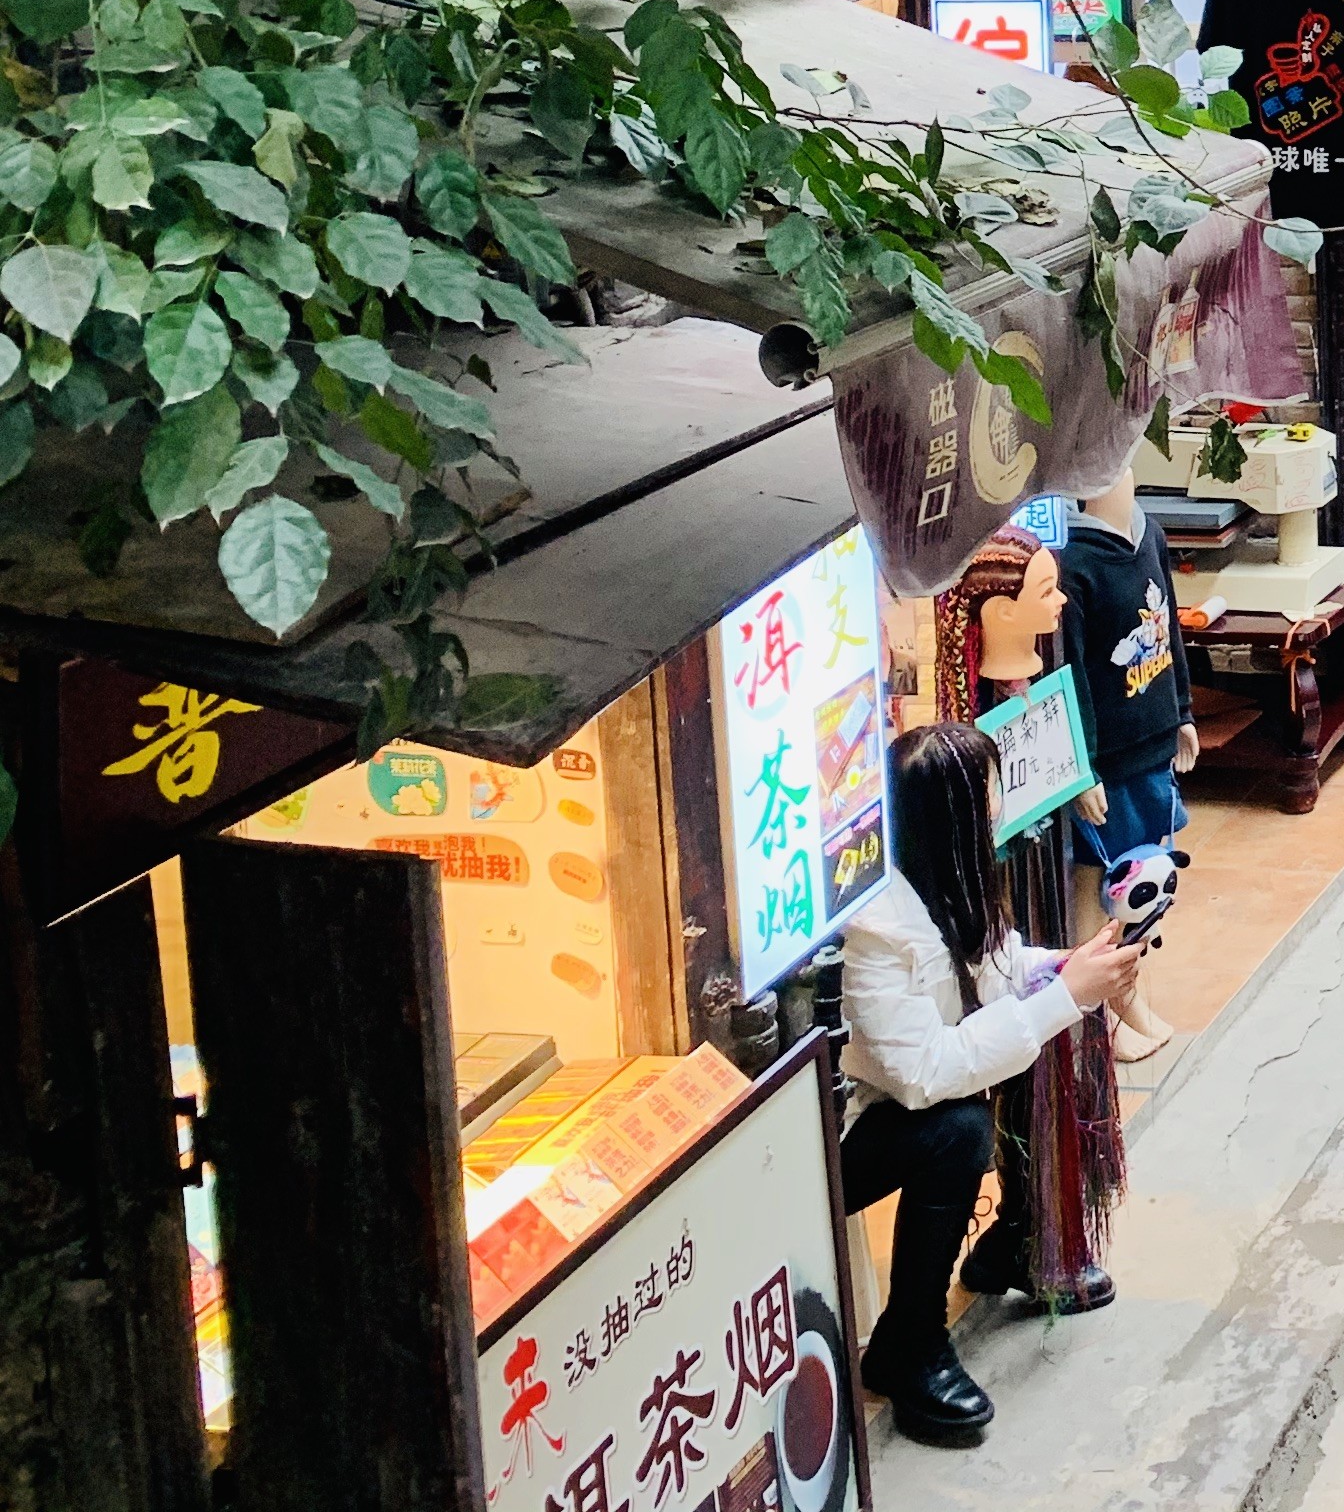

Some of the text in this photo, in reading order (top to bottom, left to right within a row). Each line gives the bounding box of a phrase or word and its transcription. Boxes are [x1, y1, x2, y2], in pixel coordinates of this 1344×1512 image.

[1278, 96, 1332, 135] 照片
[917, 377, 958, 527] 磁器口
[734, 590, 815, 954] 洱茶烟
[563, 1234, 695, 1387] 没抽过的
